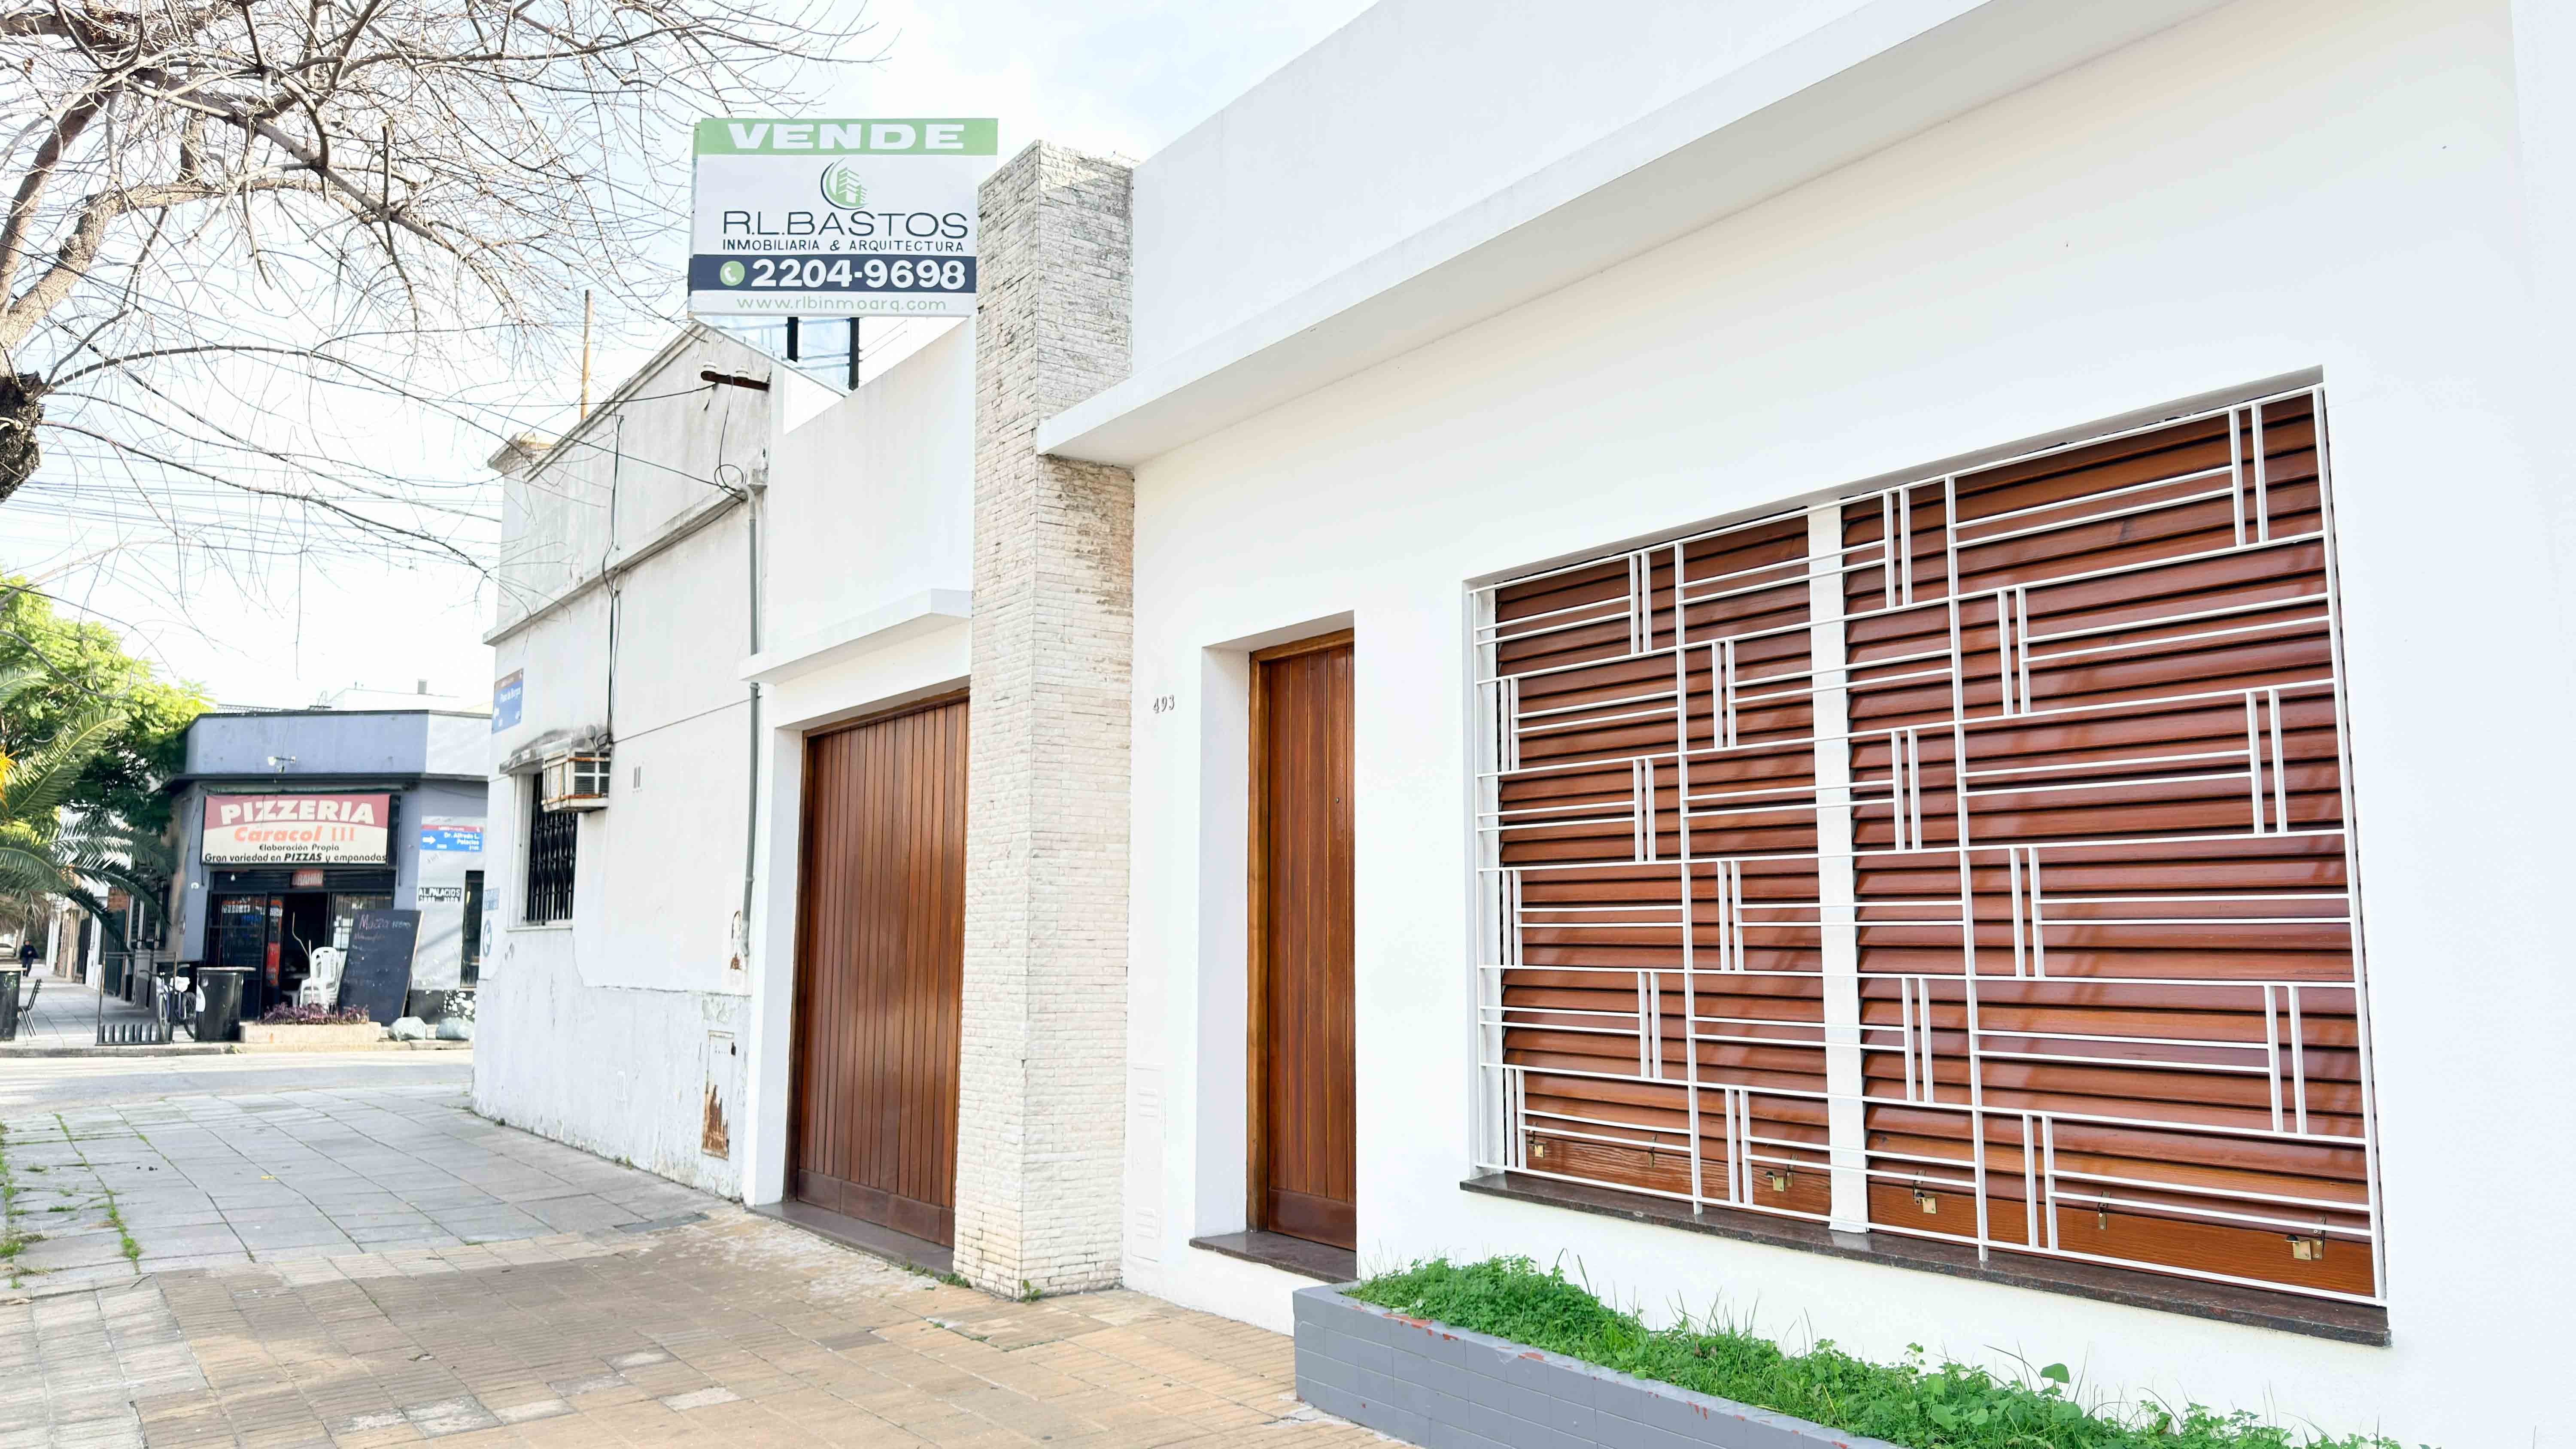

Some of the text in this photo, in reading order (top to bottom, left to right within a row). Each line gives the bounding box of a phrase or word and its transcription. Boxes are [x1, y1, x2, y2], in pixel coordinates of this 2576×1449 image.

[727, 124, 964, 149] VENDE
[723, 210, 968, 239] R.L.BASTOS
[722, 239, 964, 252] INMOBILIARIA & ARQUITECTURA
[751, 258, 966, 290] 2204-9698
[736, 296, 946, 313] www.rlbinmoarq.com
[1153, 694, 1175, 714] 493
[221, 800, 374, 825] PIZZERIA
[234, 825, 322, 842] Caracol
[312, 843, 339, 852] Propia
[205, 853, 227, 862] Gran
[230, 853, 268, 862] variedad
[284, 853, 322, 862] PIZZAS
[326, 856, 331, 864] y
[334, 853, 387, 864] empanadas
